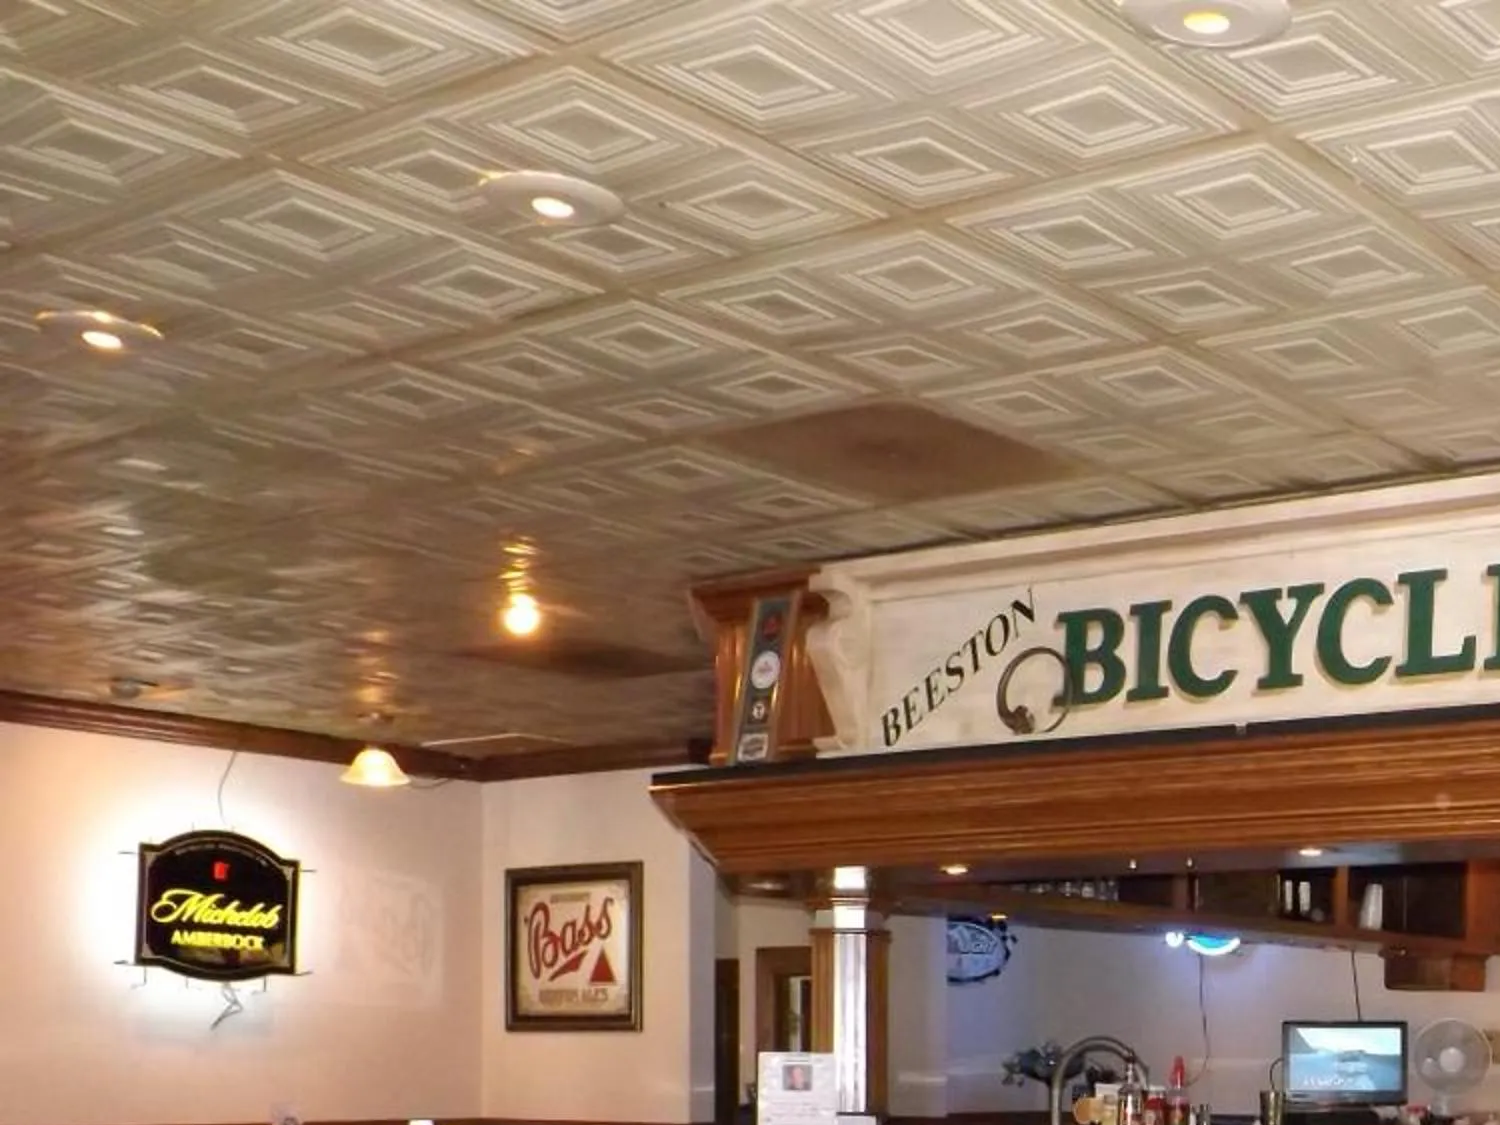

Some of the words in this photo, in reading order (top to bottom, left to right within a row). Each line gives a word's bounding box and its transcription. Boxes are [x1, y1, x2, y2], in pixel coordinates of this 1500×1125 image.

[881, 586, 1036, 747] BEESTON
[151, 888, 283, 930] Michelob
[527, 896, 615, 981] Bass
